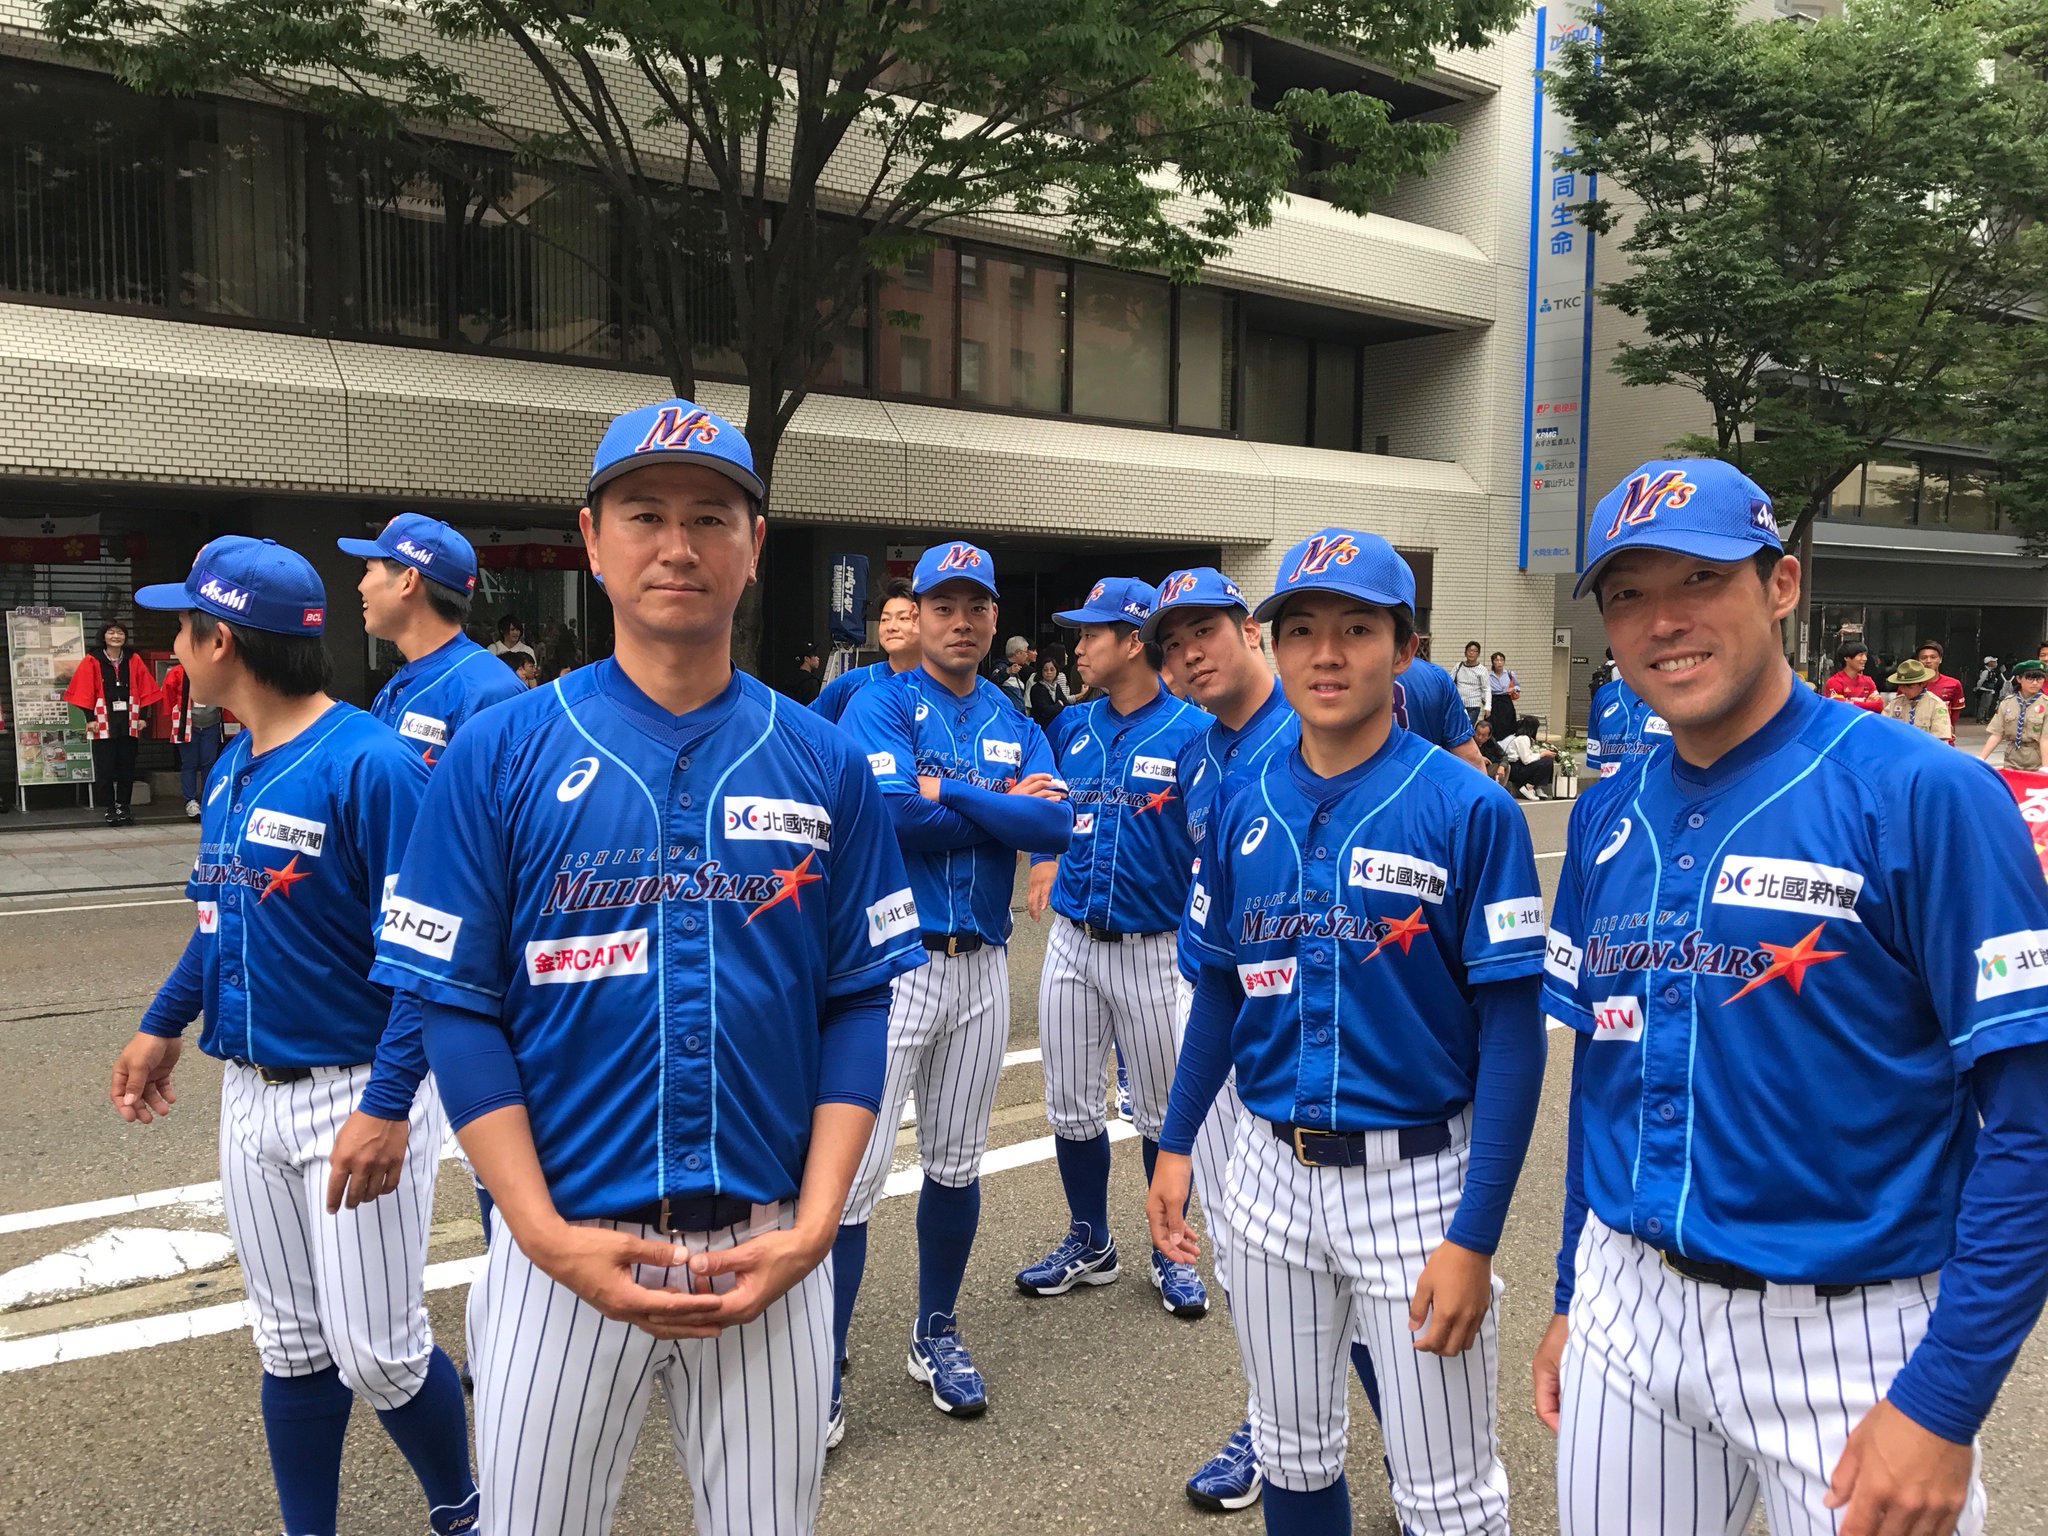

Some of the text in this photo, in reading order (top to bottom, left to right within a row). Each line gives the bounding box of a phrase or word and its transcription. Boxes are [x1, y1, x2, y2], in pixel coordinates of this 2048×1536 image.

[1550, 26, 1589, 51] DDO
[1554, 296, 1581, 311] TKC
[1536, 431, 1557, 439] KPMG
[1544, 478, 1575, 488] 富山テレビ
[396, 540, 434, 565] Asahi
[200, 580, 249, 611] Asahi
[831, 564, 843, 612] shindaiwa
[305, 613, 322, 622] BCL
[1124, 602, 1151, 623] Asah
[871, 758, 891, 769] ロン
[1106, 785, 1151, 808] STARS
[264, 821, 323, 850] 北國新聞
[763, 811, 832, 843] 北國新聞
[561, 846, 698, 870] ISHIKAWA
[540, 860, 785, 916] MILLION STARS
[1376, 863, 1445, 897] 北國新聞
[1754, 873, 1858, 912] 北國新聞
[385, 909, 452, 943] ストロン
[1592, 911, 1689, 933] ISHIKAWA
[534, 941, 641, 974] 金沢CATV
[1585, 929, 1774, 981] MILION STARS
